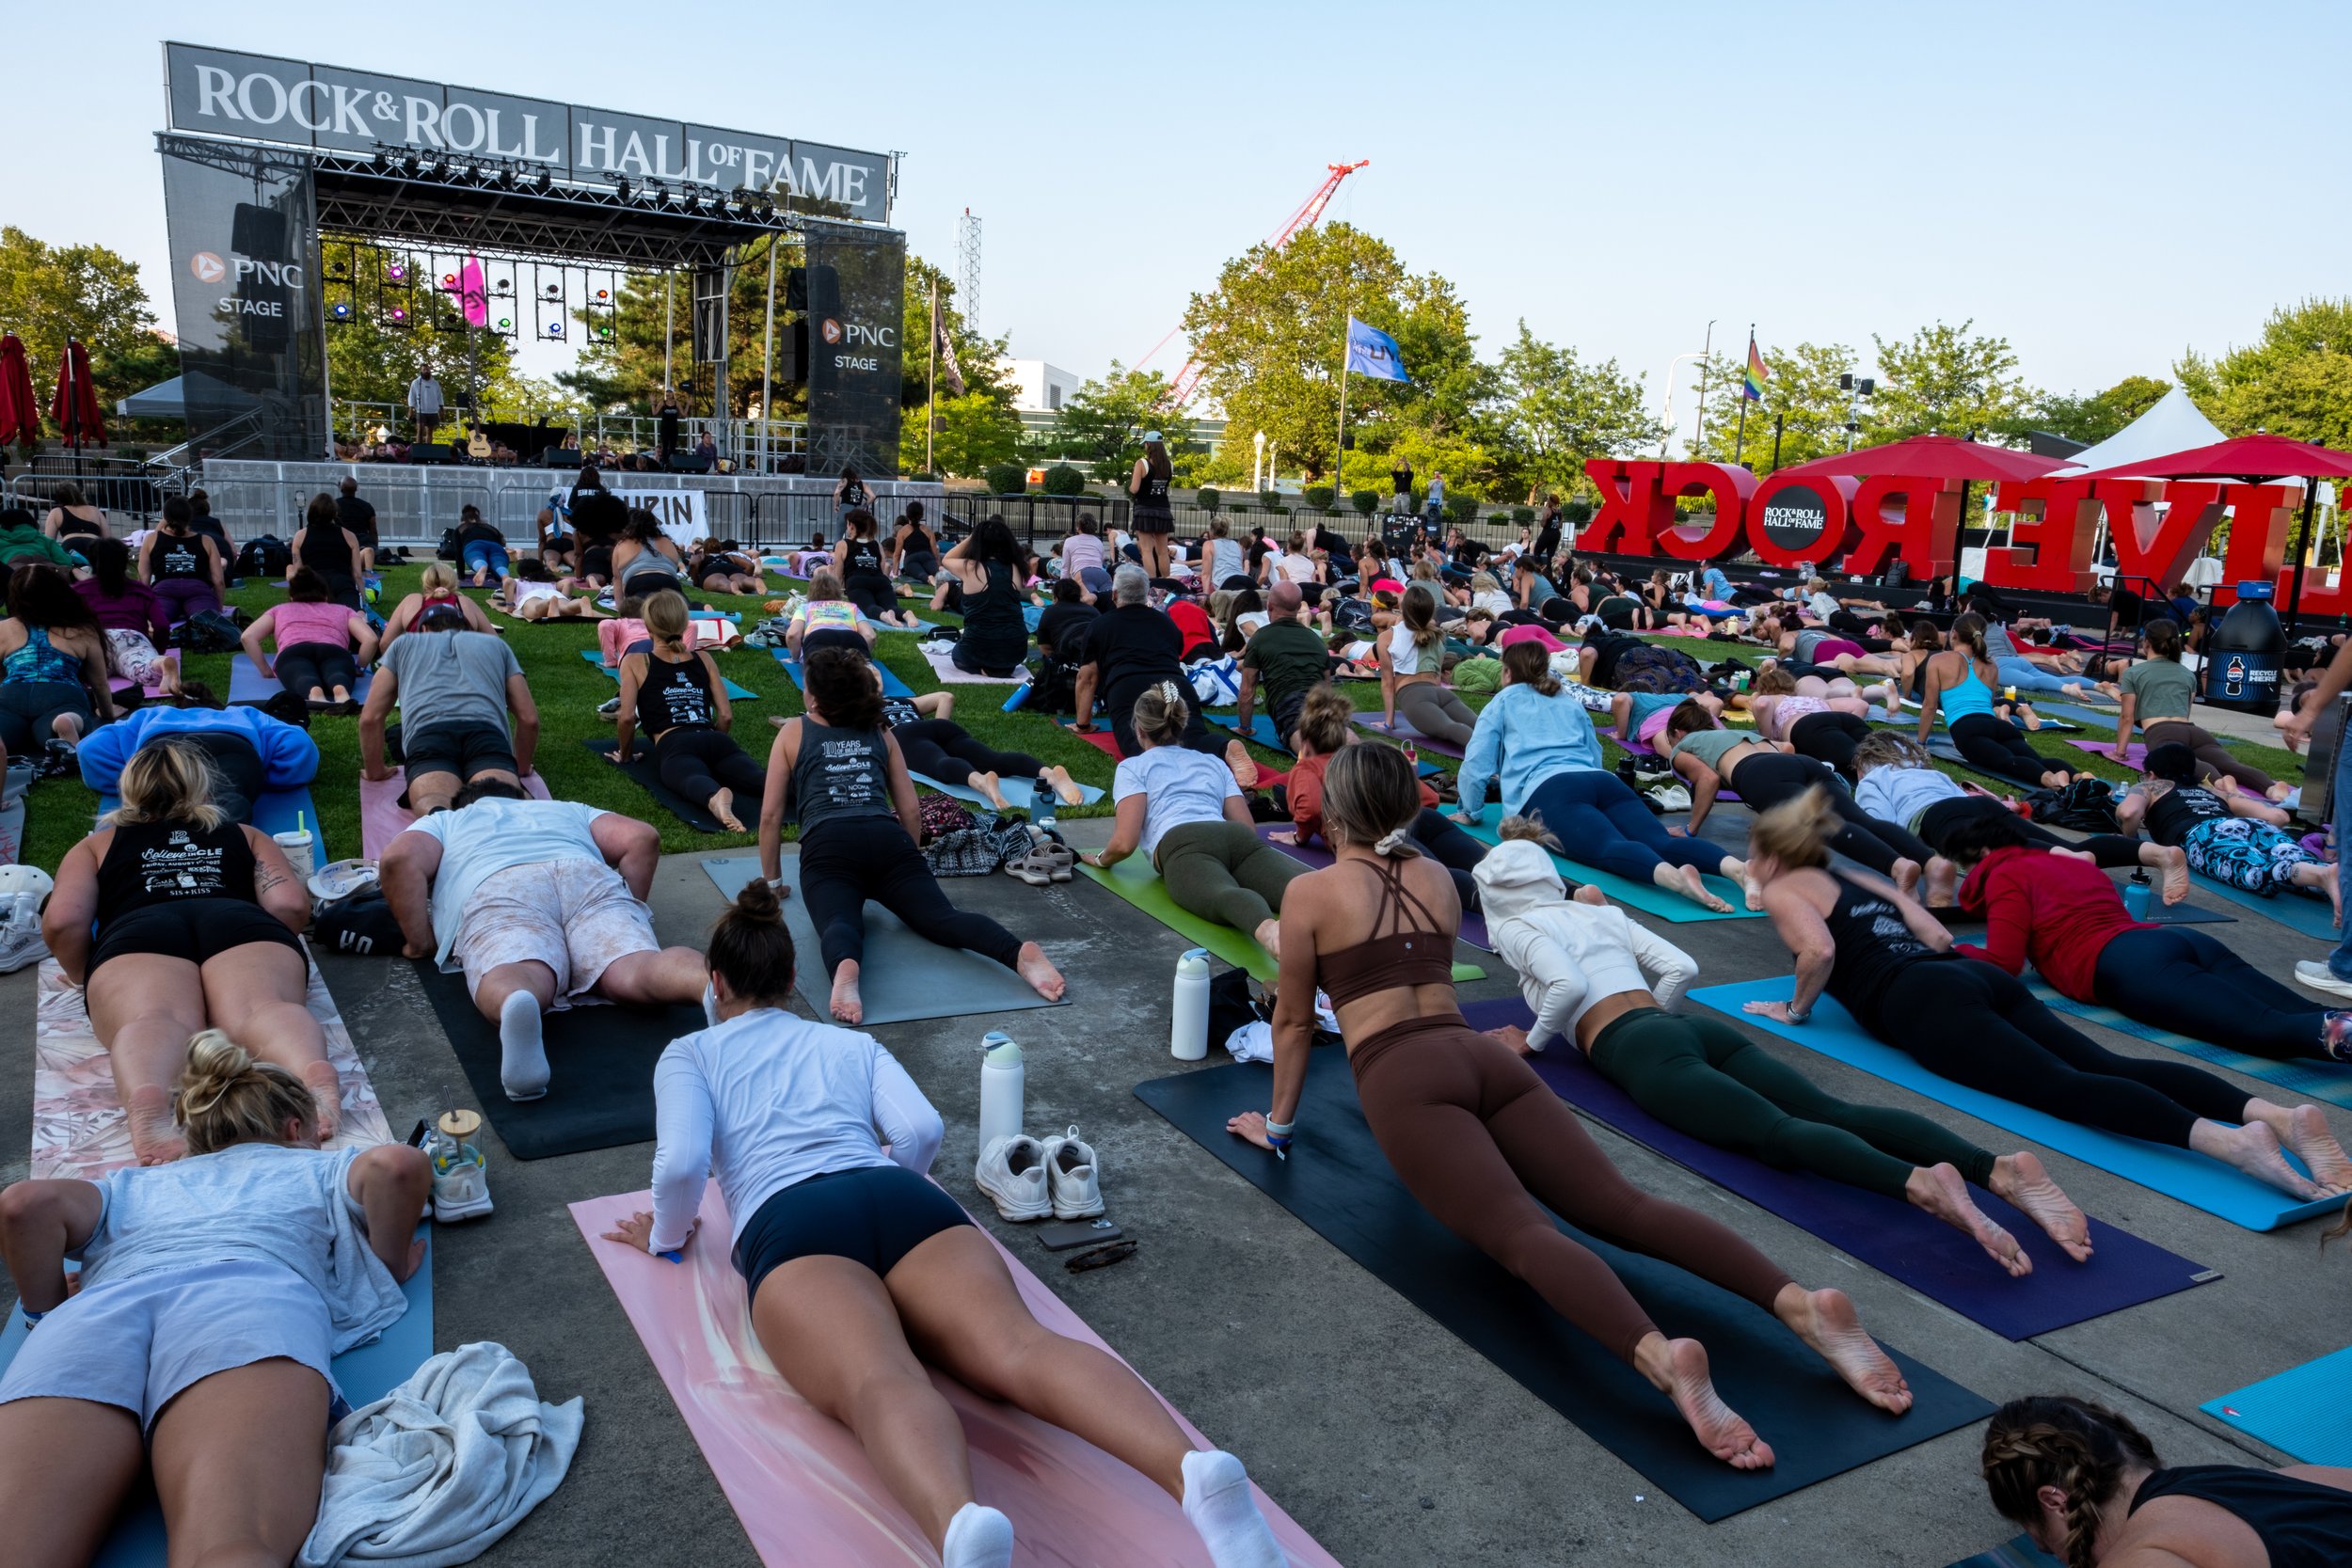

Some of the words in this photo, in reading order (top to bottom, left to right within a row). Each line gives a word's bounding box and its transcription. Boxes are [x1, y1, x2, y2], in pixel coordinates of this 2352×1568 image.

[579, 122, 718, 185] HALL
[708, 142, 742, 167] OF
[743, 148, 869, 207] FAME
[230, 258, 304, 289] PNC
[218, 297, 282, 317] STAGE
[844, 324, 895, 347] PNC
[834, 356, 878, 371] STAGE
[1764, 517, 1790, 527] HALL
[1795, 519, 1823, 529] FAME
[822, 741, 836, 755] 10
[836, 739, 861, 749] YEARS
[141, 847, 187, 861] Believe
[196, 847, 223, 857] CLE
[191, 887, 211, 895] KISS
